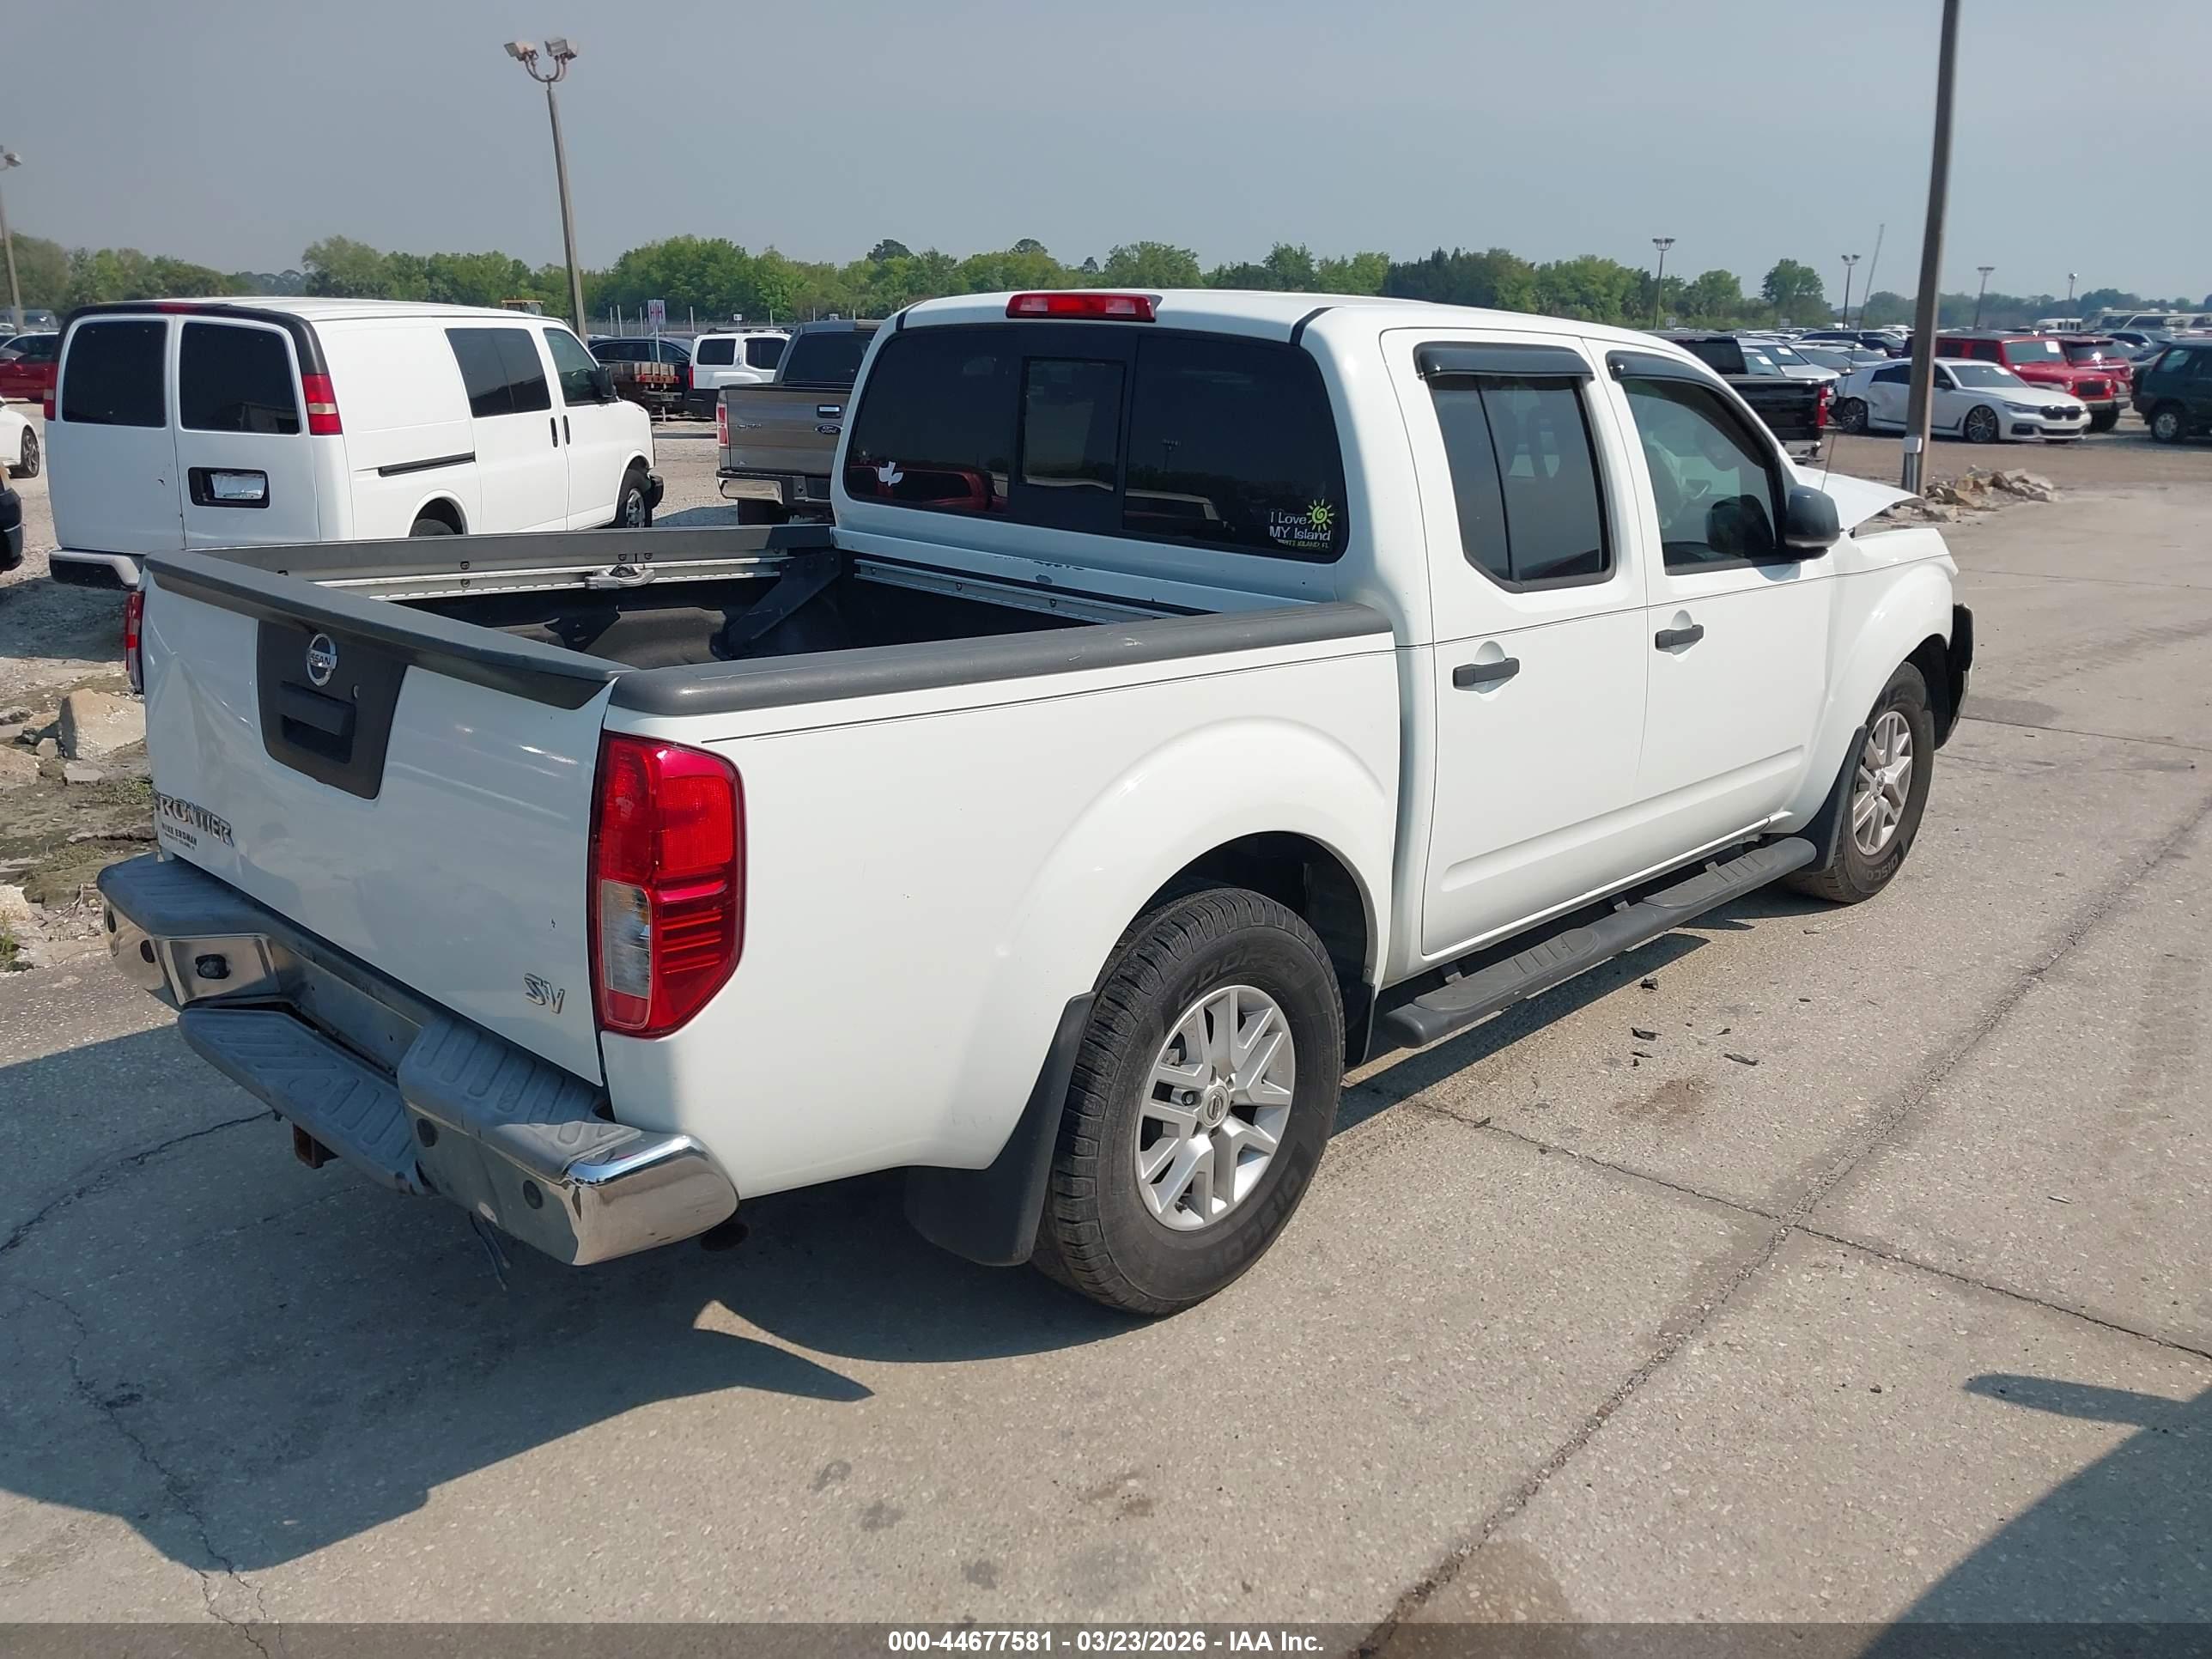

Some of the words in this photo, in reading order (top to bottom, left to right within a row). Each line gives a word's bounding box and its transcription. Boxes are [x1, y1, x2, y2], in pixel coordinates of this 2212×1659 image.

[1271, 511, 1274, 524] I
[1278, 512, 1307, 526] Love
[1269, 526, 1291, 539] MY
[1294, 527, 1331, 542] Island
[524, 972, 565, 1014] SV
